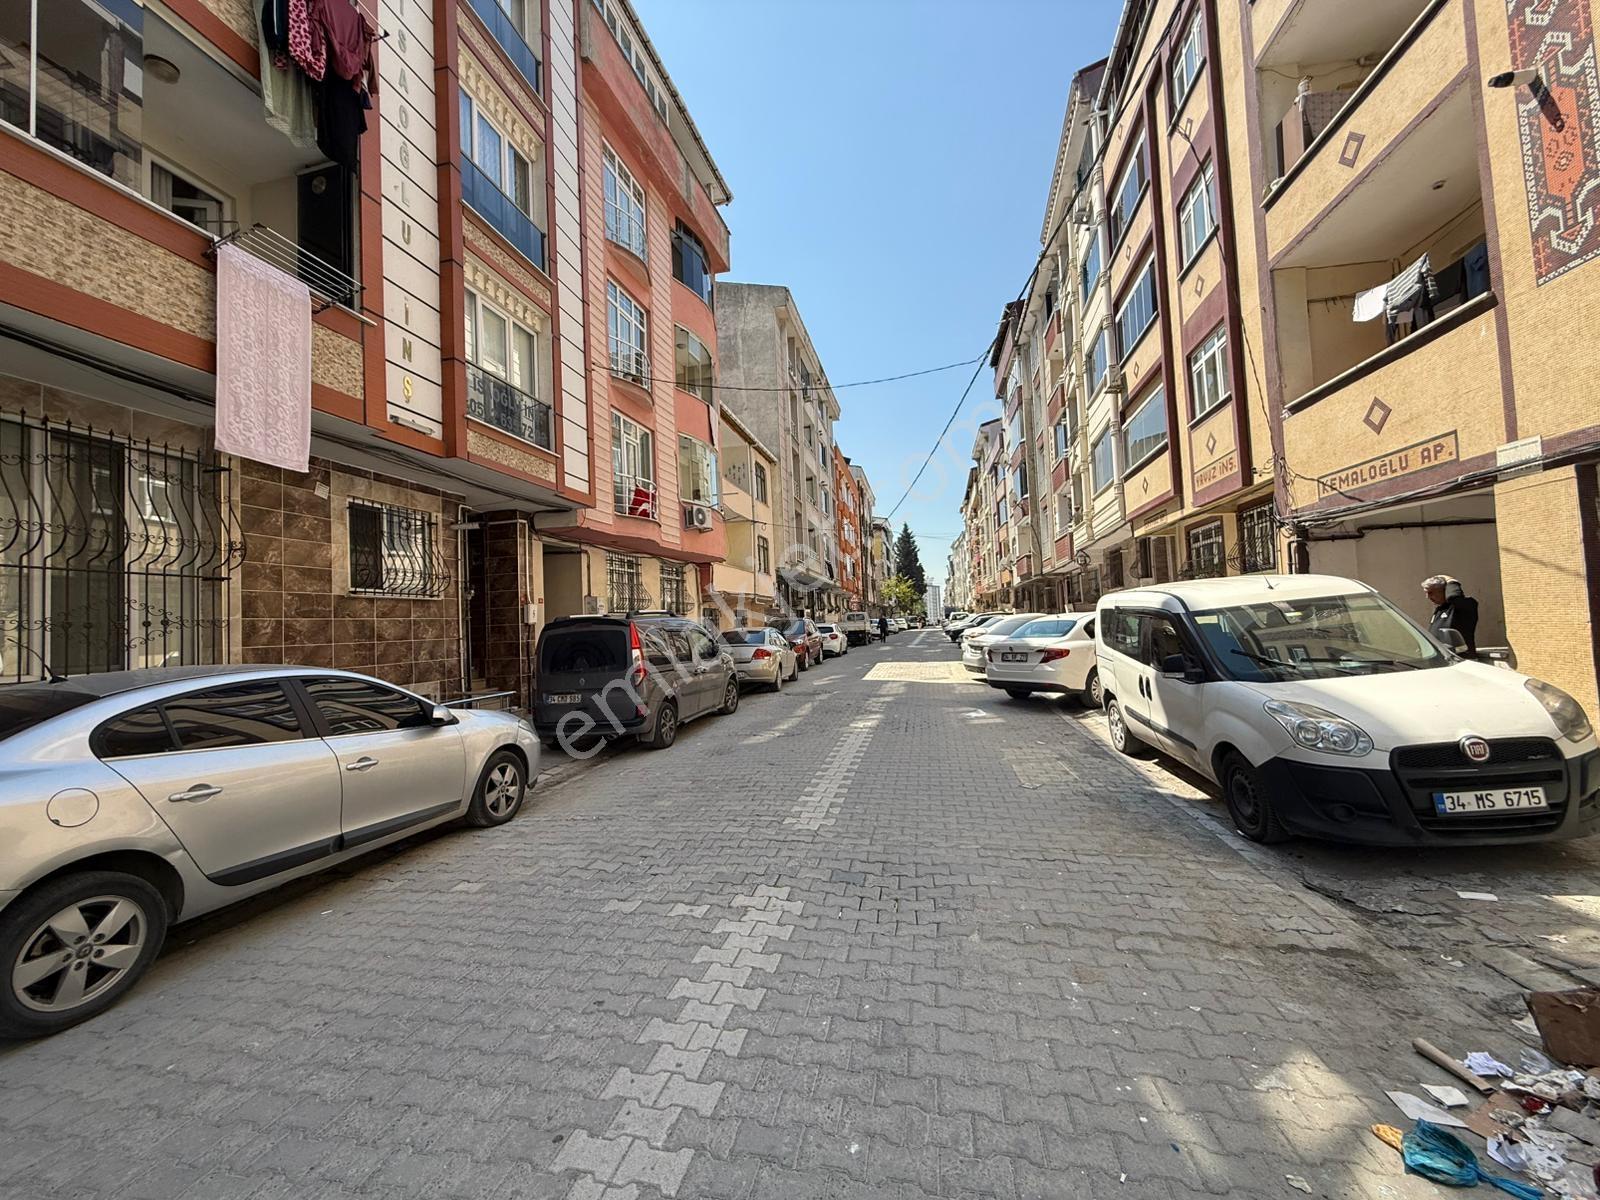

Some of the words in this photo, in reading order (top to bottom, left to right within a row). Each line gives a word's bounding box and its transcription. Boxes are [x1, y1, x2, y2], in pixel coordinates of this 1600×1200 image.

[1321, 454, 1409, 495] KEMALOĞLU
[1420, 442, 1453, 465] AP.
[1470, 745, 1485, 755] FIAT
[1446, 795, 1466, 811] 34
[1474, 793, 1496, 809] MS
[1503, 790, 1542, 807] 6715
